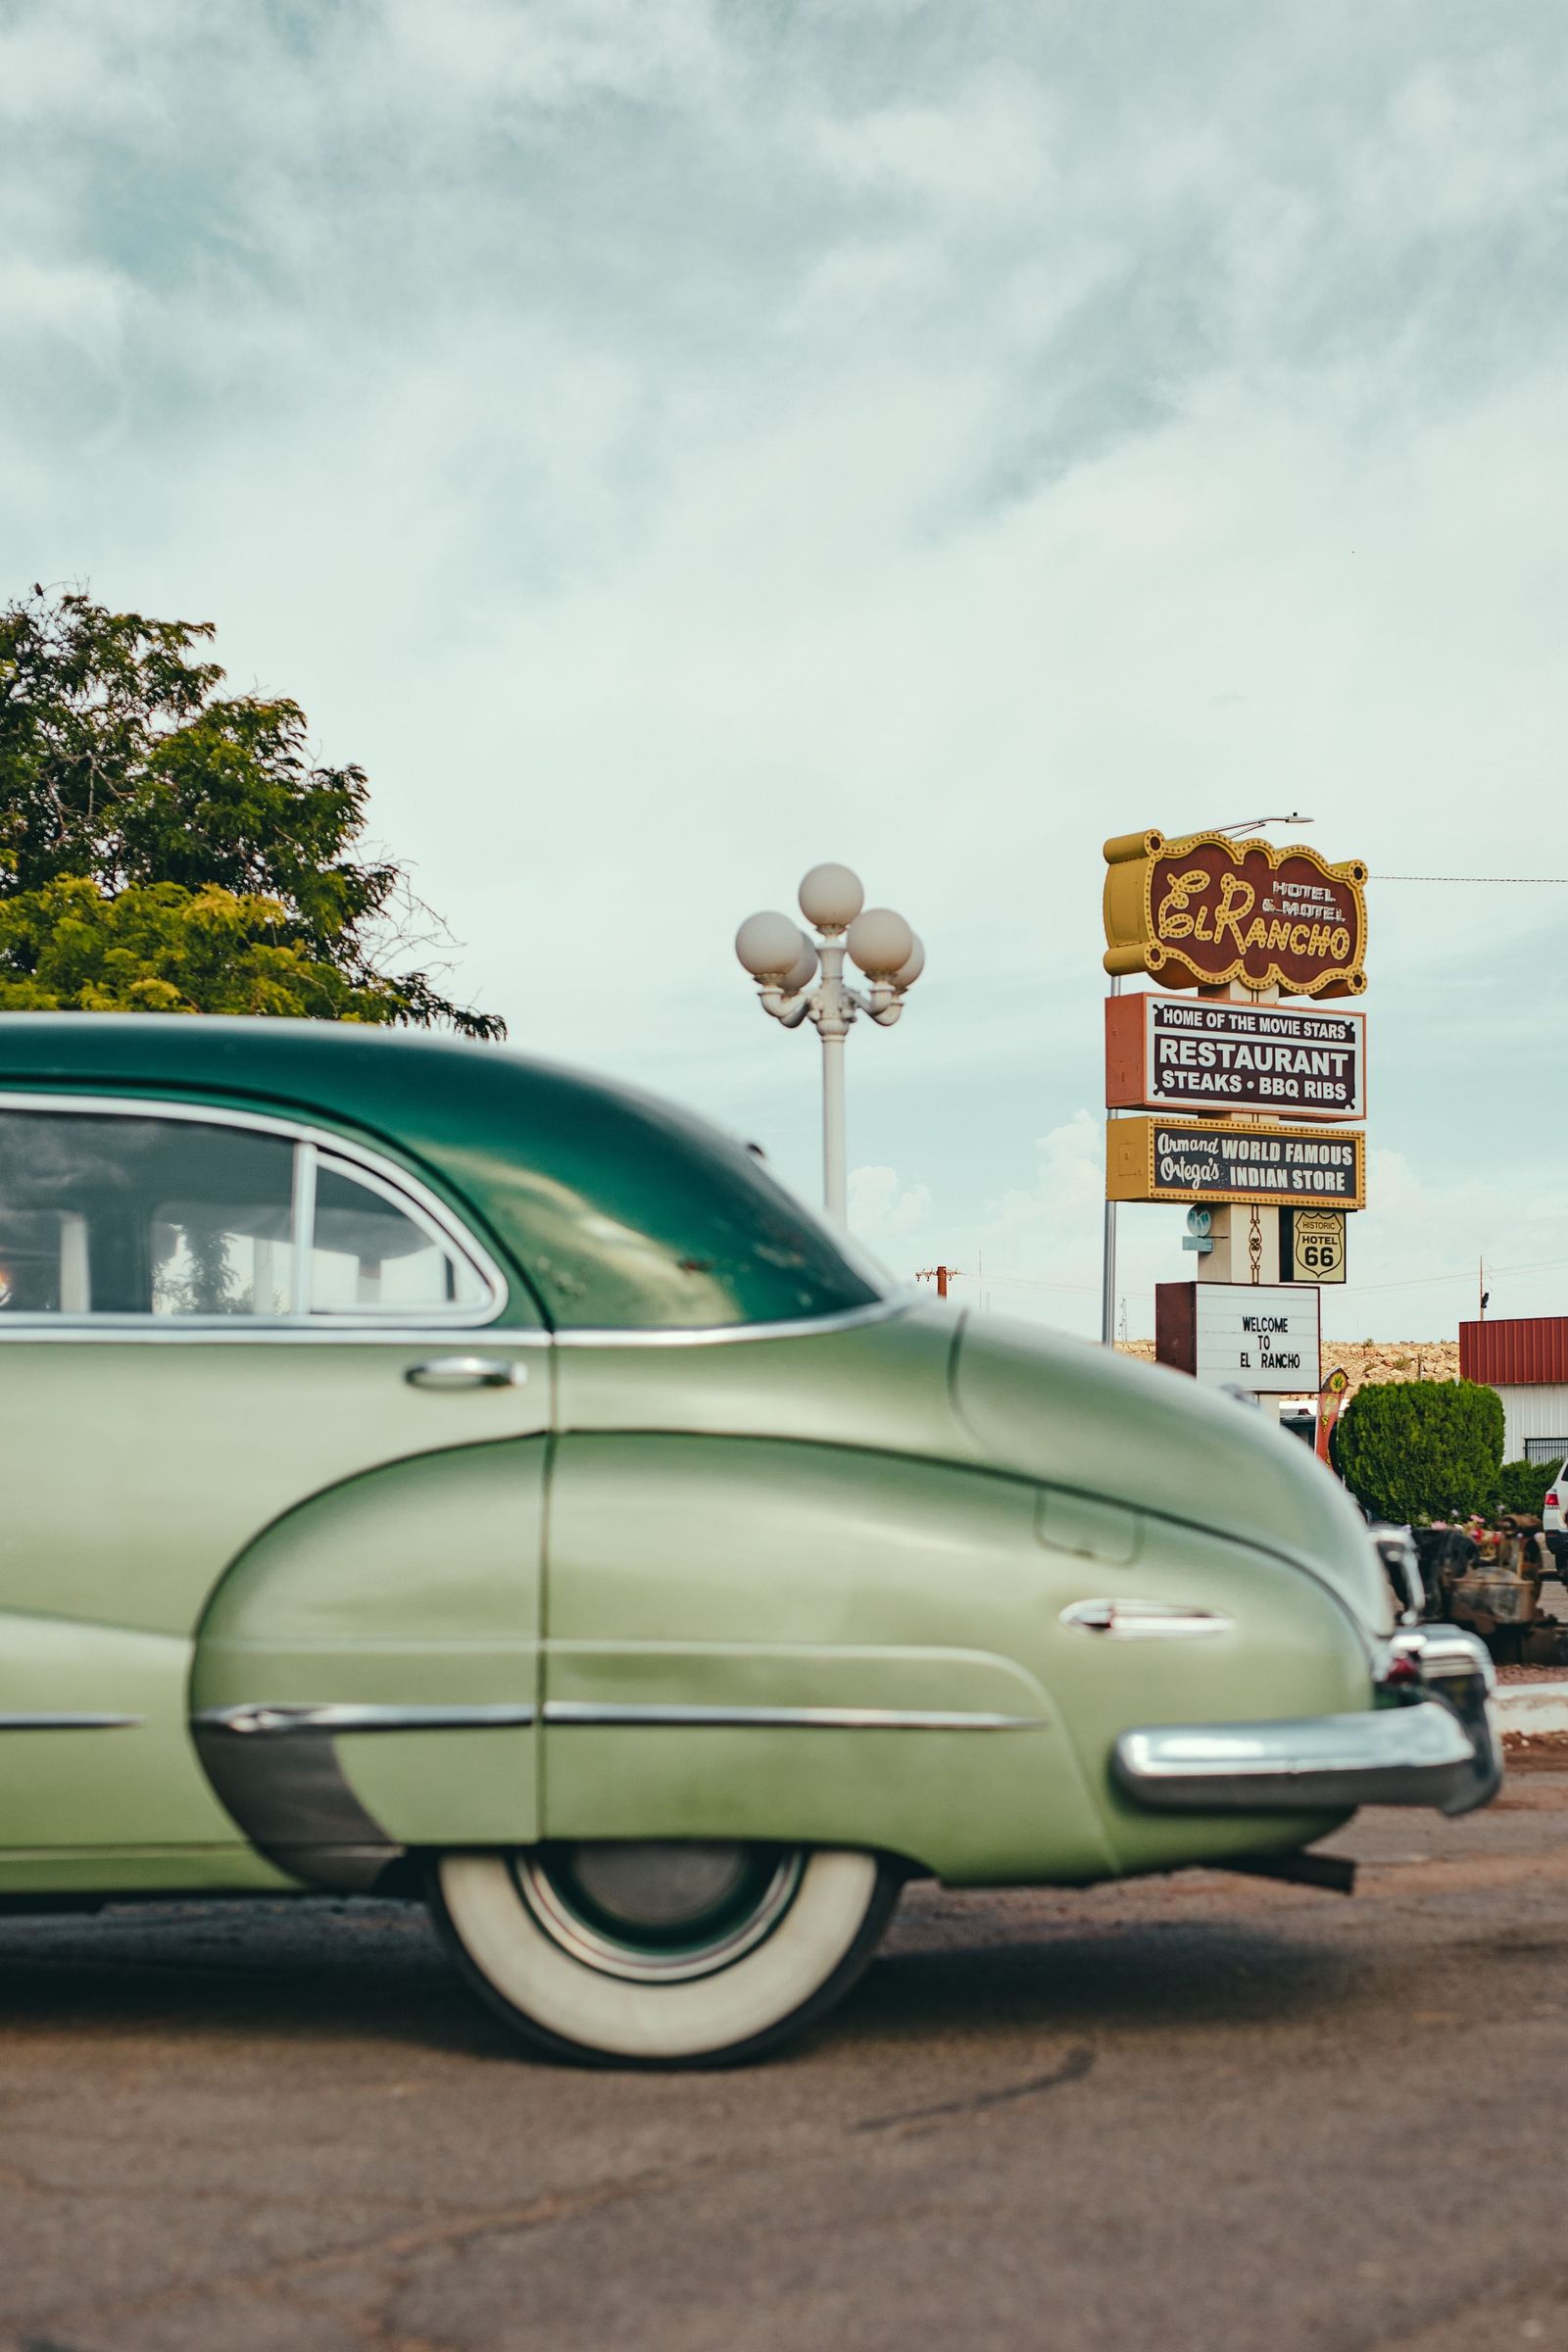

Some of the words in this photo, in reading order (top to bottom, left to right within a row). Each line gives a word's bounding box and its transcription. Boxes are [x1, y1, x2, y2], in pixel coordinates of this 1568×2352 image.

[1273, 880, 1336, 903] HOTEL
[1261, 898, 1275, 912] &
[1282, 900, 1347, 922] MOTEL
[1163, 1008, 1202, 1027] HOME
[1205, 1012, 1225, 1029] OF
[1228, 1014, 1256, 1031] THE
[1259, 1016, 1300, 1036] MOVIE
[1303, 1020, 1347, 1040] STARS
[1159, 1038, 1348, 1077] RESTAURANT
[1161, 1070, 1243, 1093] STEAKS
[1258, 1076, 1299, 1099] BBQ
[1303, 1081, 1348, 1101] RIBS
[1221, 1139, 1281, 1162] WORLD
[1285, 1143, 1352, 1166] FAMOUS
[1159, 1156, 1220, 1190] Ortega's
[1230, 1166, 1288, 1189] INDIAN
[1292, 1169, 1346, 1192] STORE
[1302, 1221, 1336, 1230] HISTORIC
[1301, 1236, 1338, 1245] HOTEL
[1304, 1246, 1334, 1267] 66
[1242, 1316, 1289, 1333] WELCOME
[1257, 1335, 1271, 1350] TO
[1240, 1351, 1251, 1368] EL
[1260, 1352, 1300, 1369] RANCHO
